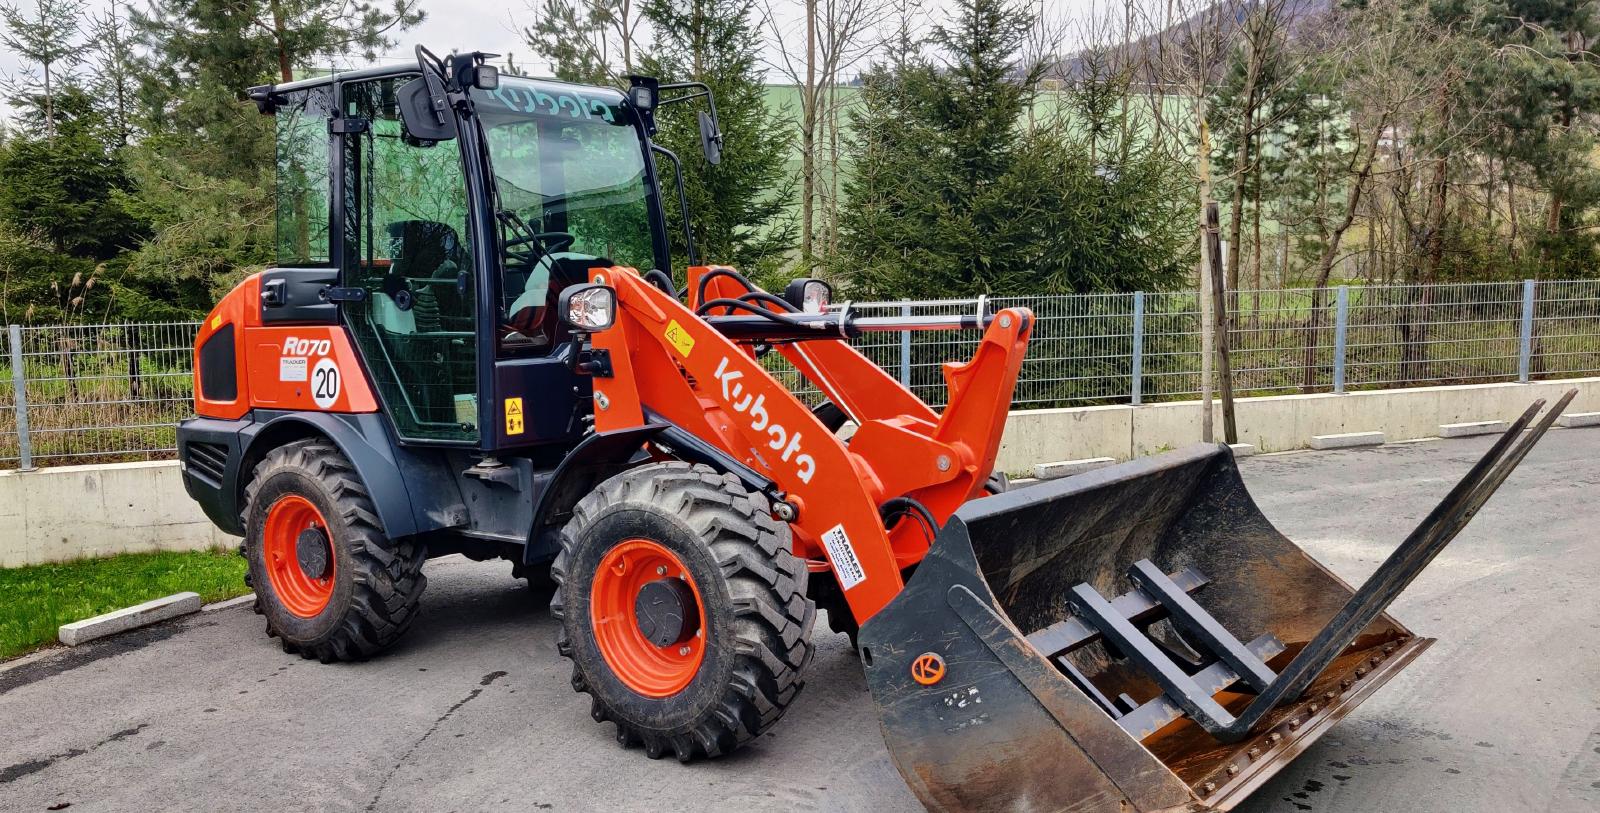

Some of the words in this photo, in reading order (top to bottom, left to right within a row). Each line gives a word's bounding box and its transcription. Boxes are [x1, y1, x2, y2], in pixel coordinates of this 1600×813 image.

[485, 83, 615, 122] Kubota
[282, 336, 331, 356] R070
[315, 367, 337, 399] 20
[713, 356, 816, 485] Kubota
